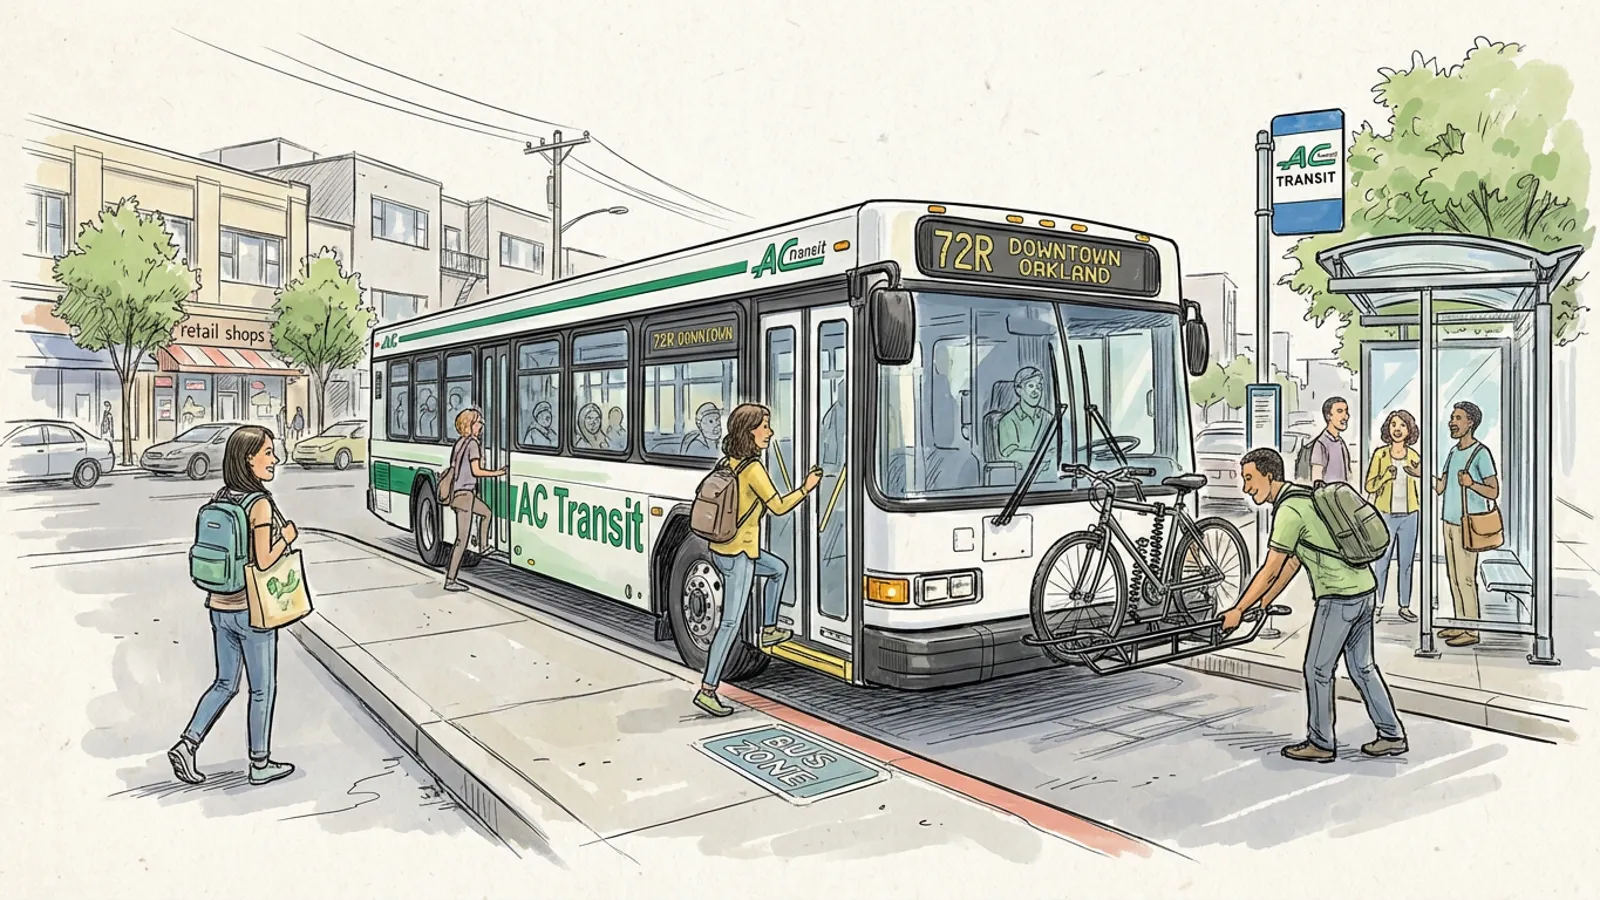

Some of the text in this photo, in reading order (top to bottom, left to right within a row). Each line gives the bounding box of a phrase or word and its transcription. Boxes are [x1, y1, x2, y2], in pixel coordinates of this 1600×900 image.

[1276, 143, 1336, 170] AC
[1276, 171, 1336, 187] TRANSIT
[751, 237, 825, 279] AC
[934, 229, 1121, 272] 72R DOWNTOWN
[181, 323, 265, 346] retail shops
[653, 332, 675, 349] 72R
[517, 481, 644, 553] AC Transit
[723, 739, 819, 787] ZONE
[760, 735, 837, 769] BUS
